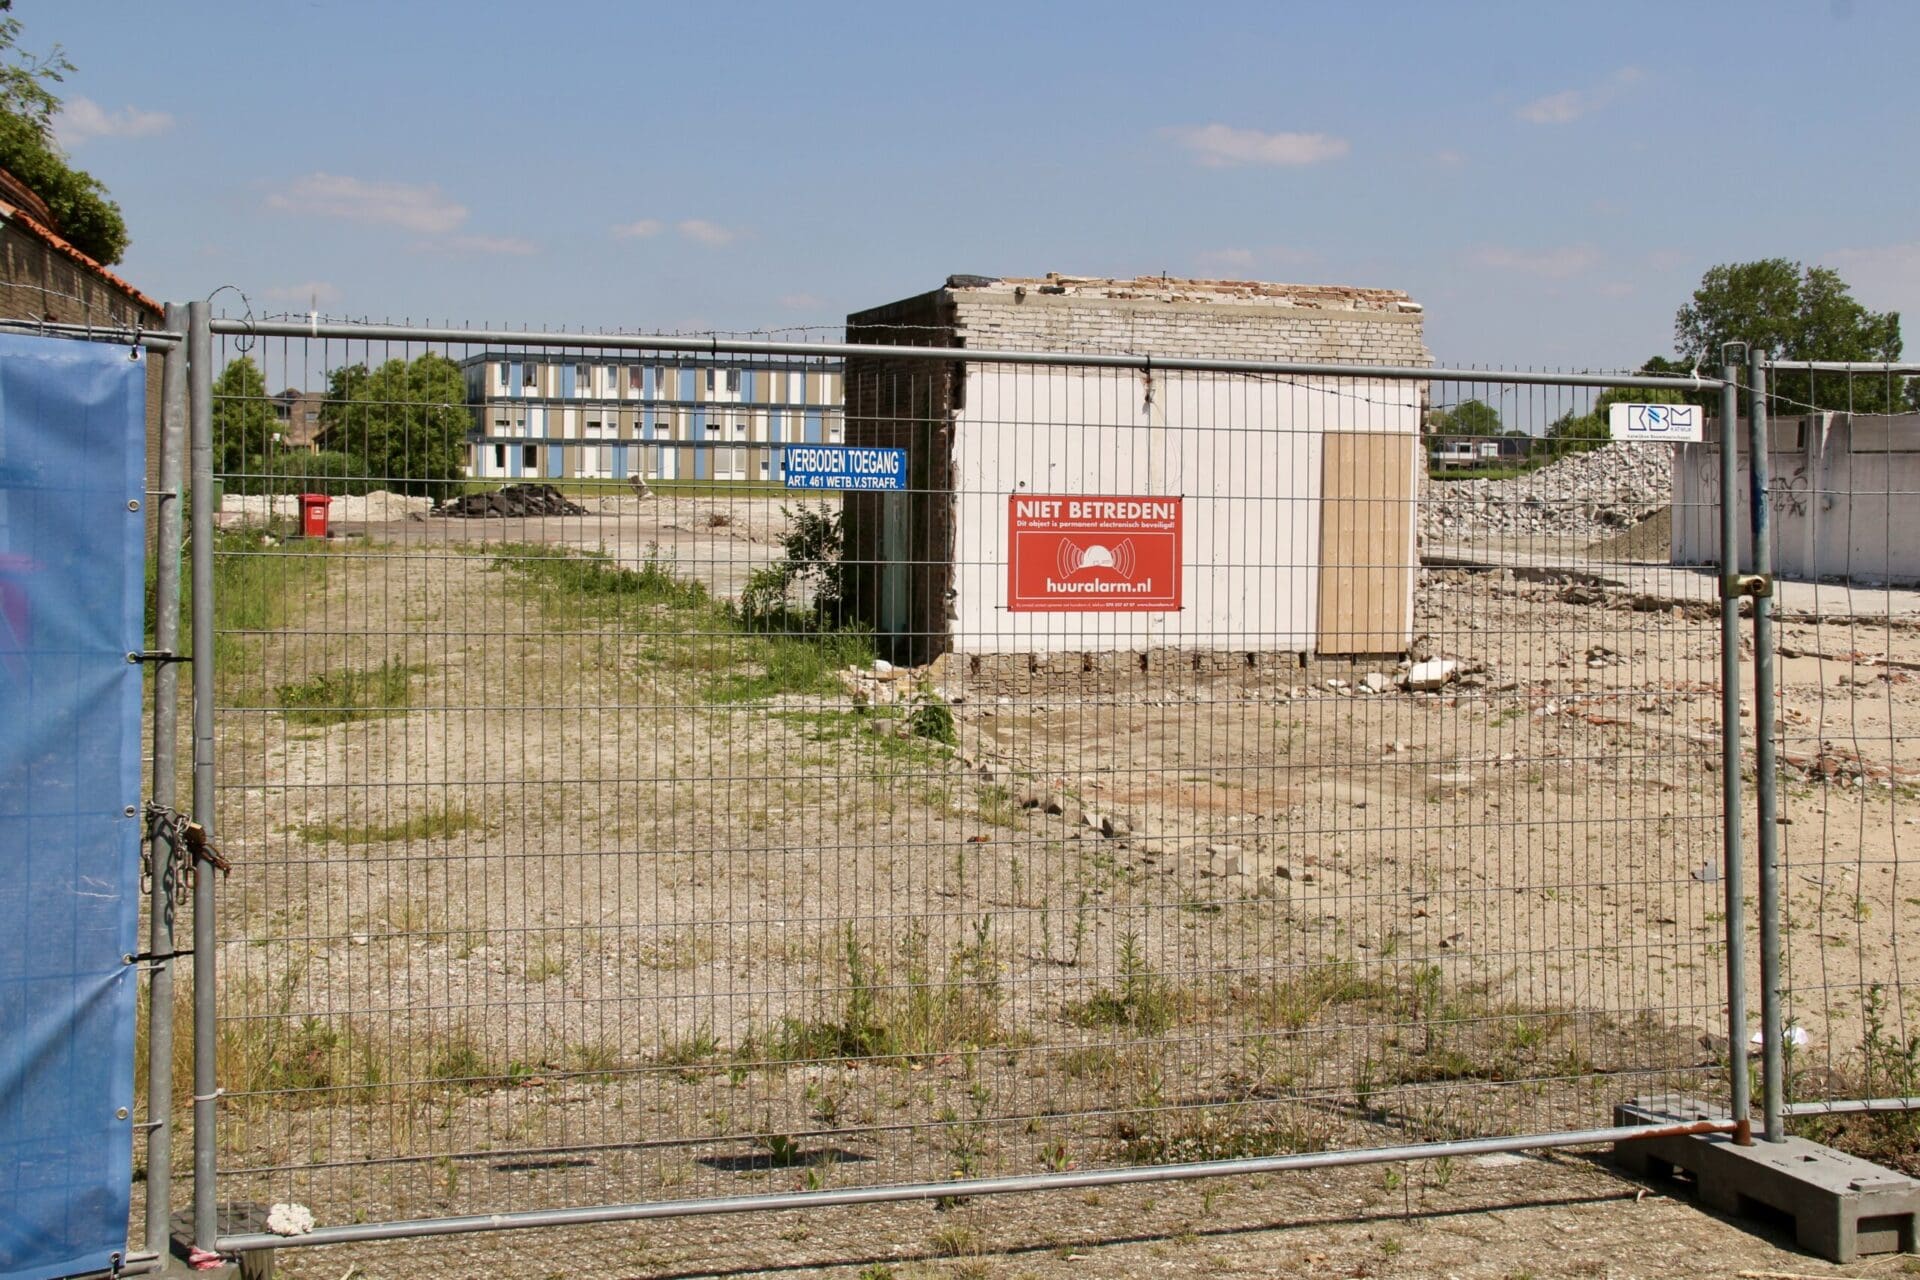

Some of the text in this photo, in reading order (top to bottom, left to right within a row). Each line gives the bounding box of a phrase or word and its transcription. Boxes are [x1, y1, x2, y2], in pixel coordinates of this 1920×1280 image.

[1628, 405, 1692, 431] KBM
[787, 448, 899, 474] VERBODEN TOEGANG
[787, 475, 807, 487] ART.
[809, 475, 824, 487] 461
[1016, 501, 1176, 520] NIET BETREDEN!
[1028, 520, 1050, 528] object
[1059, 521, 1098, 529] permanent
[1046, 577, 1152, 593] huuralarm.nl
